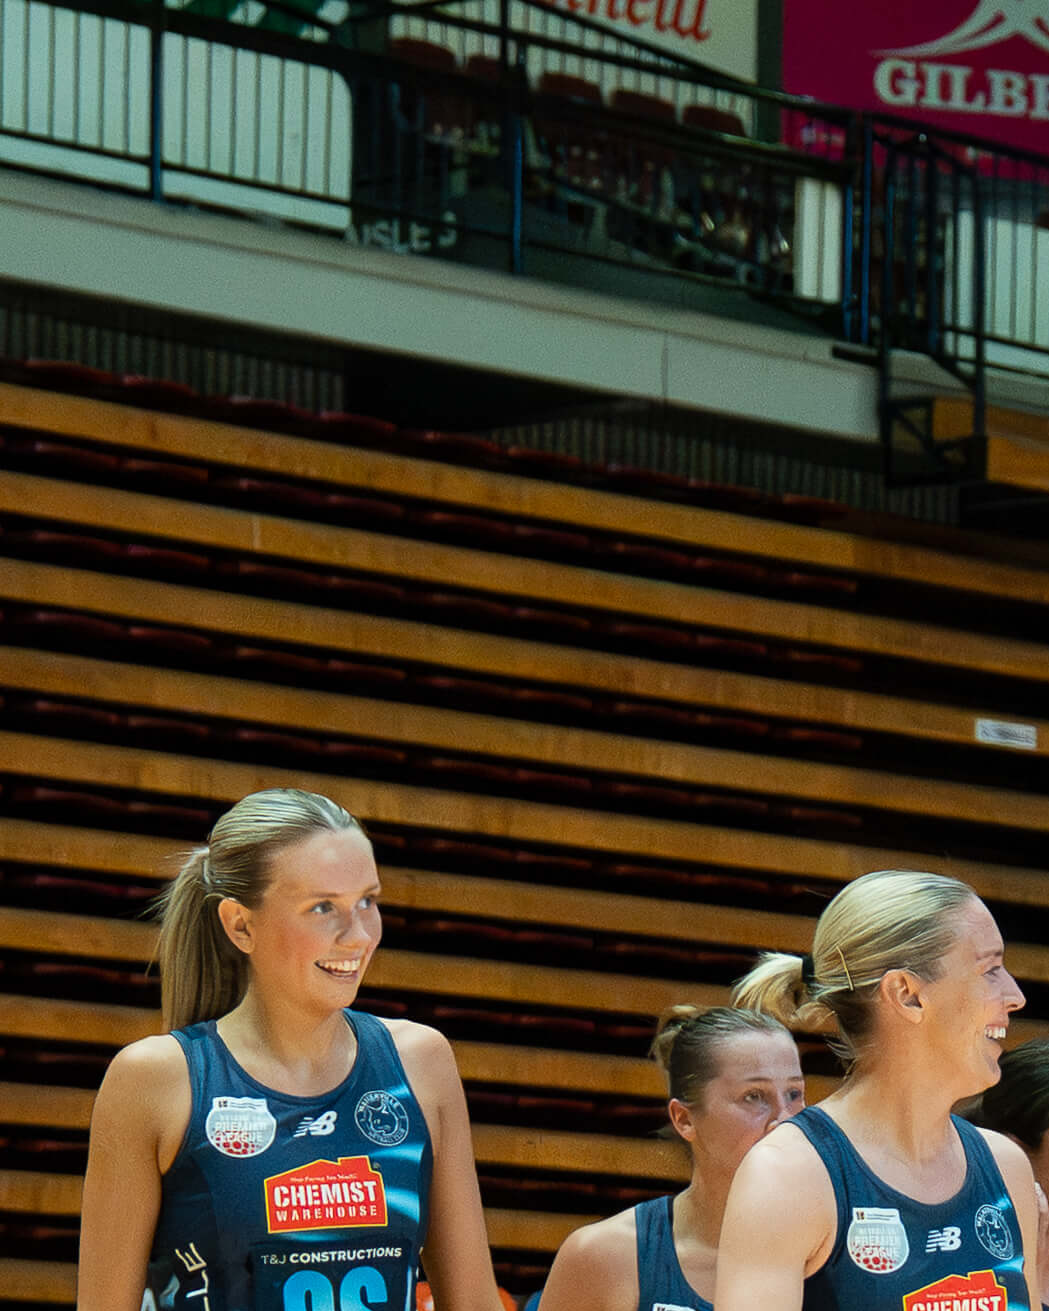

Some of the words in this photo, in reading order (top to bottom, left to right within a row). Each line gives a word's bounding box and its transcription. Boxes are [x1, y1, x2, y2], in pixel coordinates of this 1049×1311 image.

[274, 1181, 377, 1208] CHEMIST
[276, 1205, 377, 1222] WAREHOUSE
[261, 1254, 286, 1265] T&J
[289, 1247, 402, 1264] CONSTRUCTIONS
